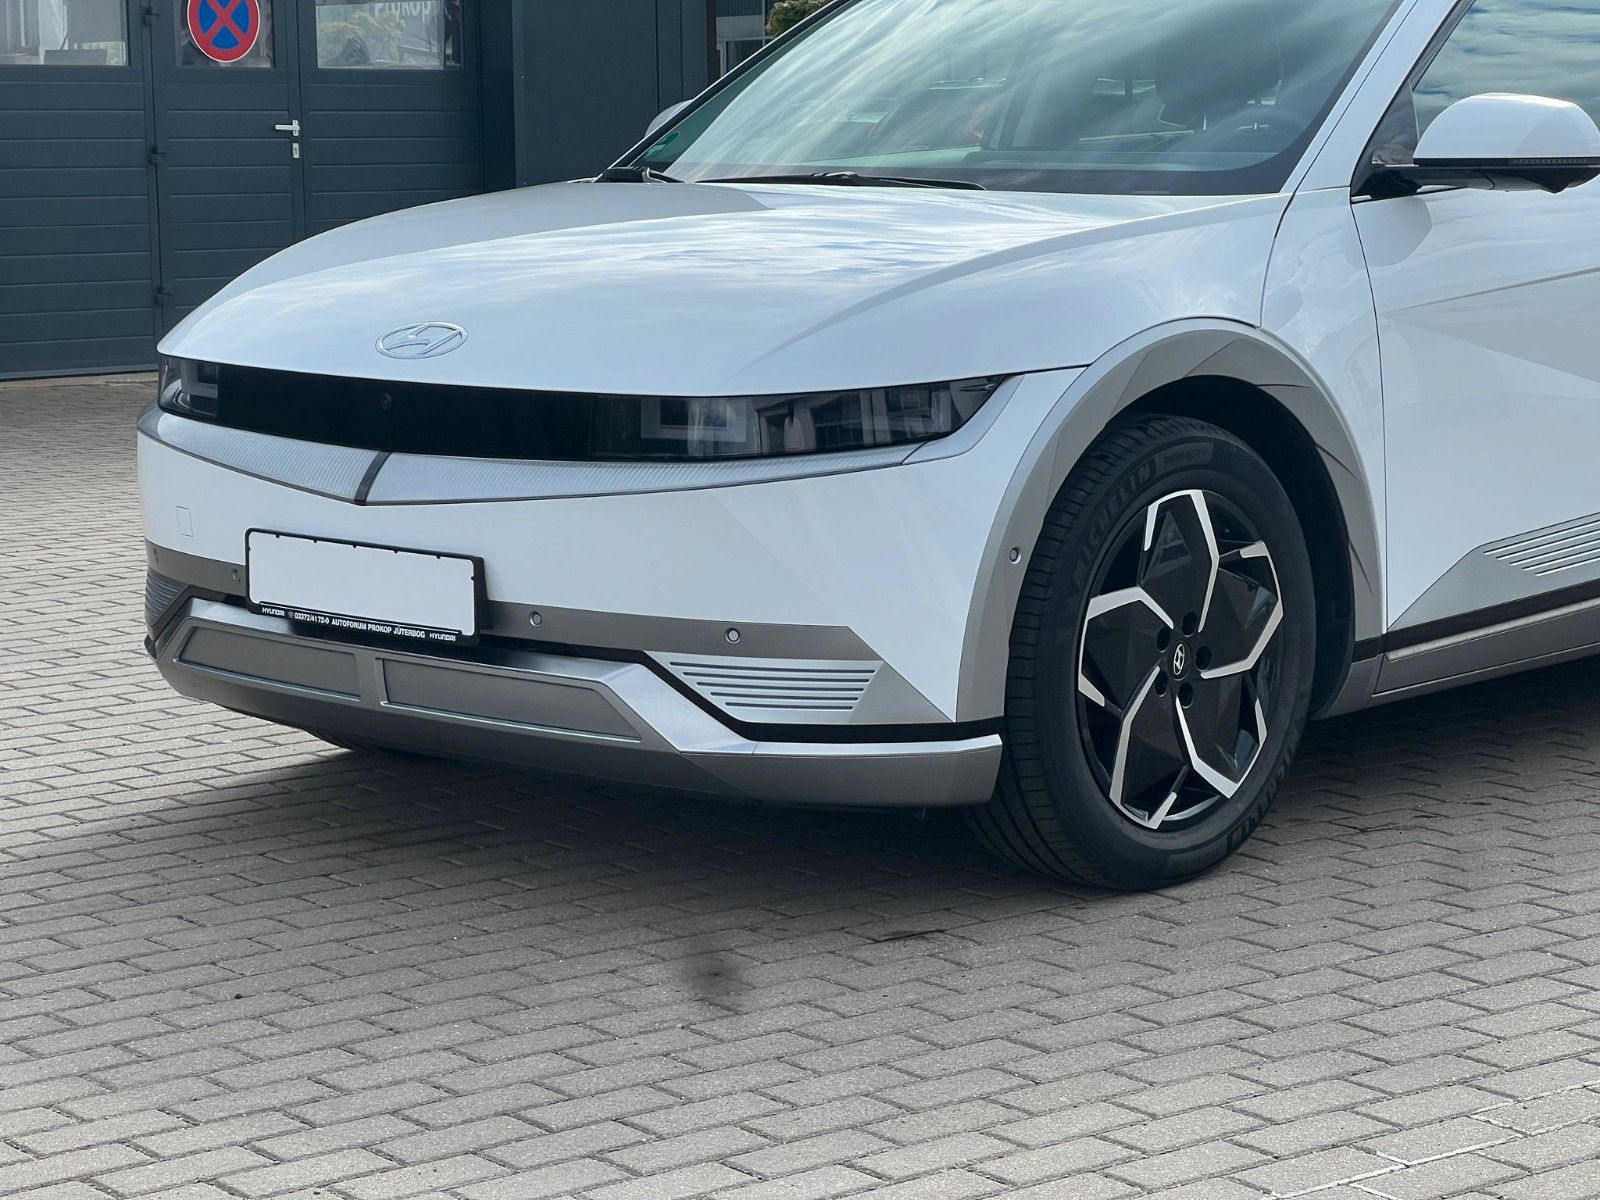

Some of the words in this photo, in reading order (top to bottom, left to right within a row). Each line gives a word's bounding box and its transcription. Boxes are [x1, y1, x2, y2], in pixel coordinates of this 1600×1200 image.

[262, 607, 285, 617] HYUNDAI
[332, 618, 367, 630] AUTOFORUM
[367, 624, 392, 634] PROKOP
[393, 626, 425, 638] JÜTERBOG
[429, 632, 456, 642] HYUNDAI
